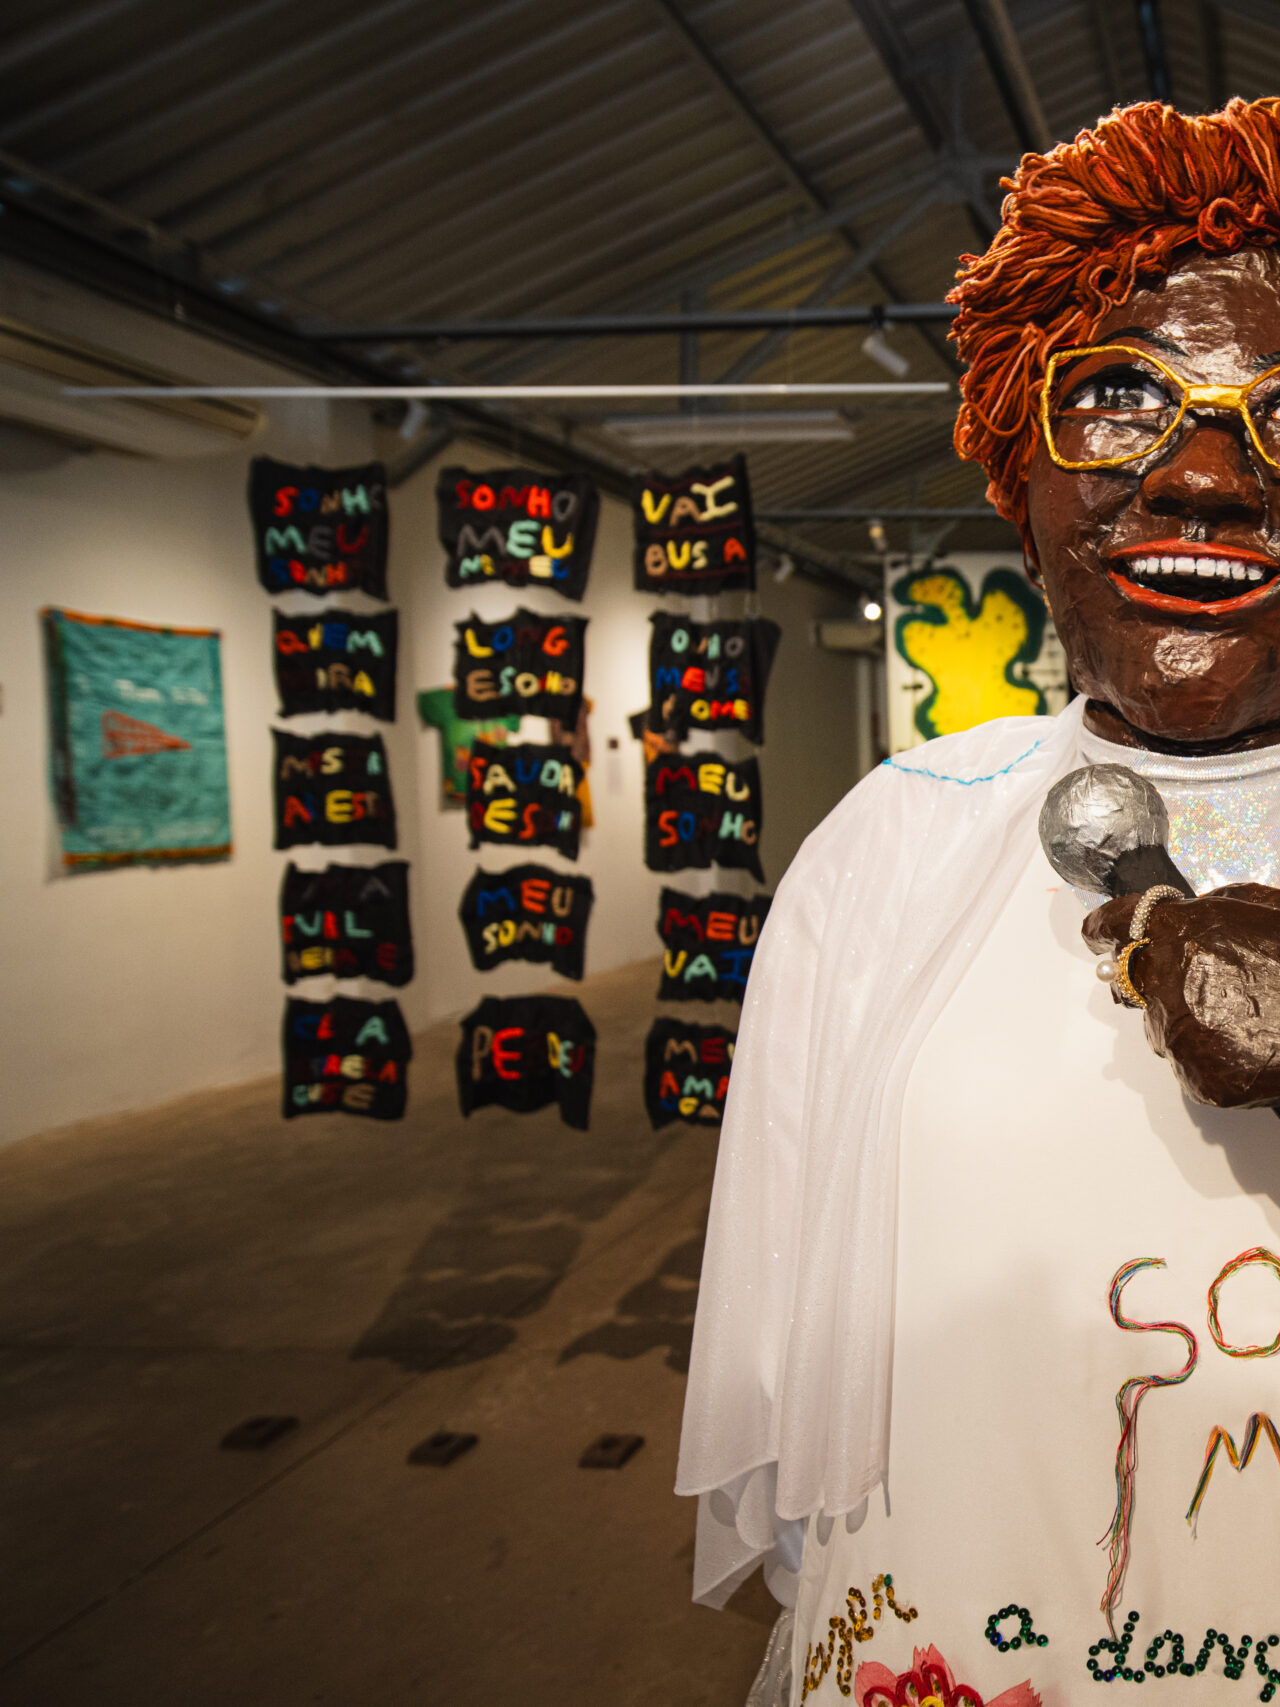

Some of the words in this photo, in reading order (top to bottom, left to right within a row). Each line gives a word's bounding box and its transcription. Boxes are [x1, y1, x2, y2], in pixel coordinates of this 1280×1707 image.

[456, 479, 577, 523] SONHO
[641, 475, 738, 527] VAI
[456, 519, 574, 560] MEU
[656, 762, 751, 803] MEU
[476, 878, 572, 919] MEU
[664, 908, 759, 947] MEU
[664, 948, 754, 985] VAI
[984, 1603, 1048, 1653] a
